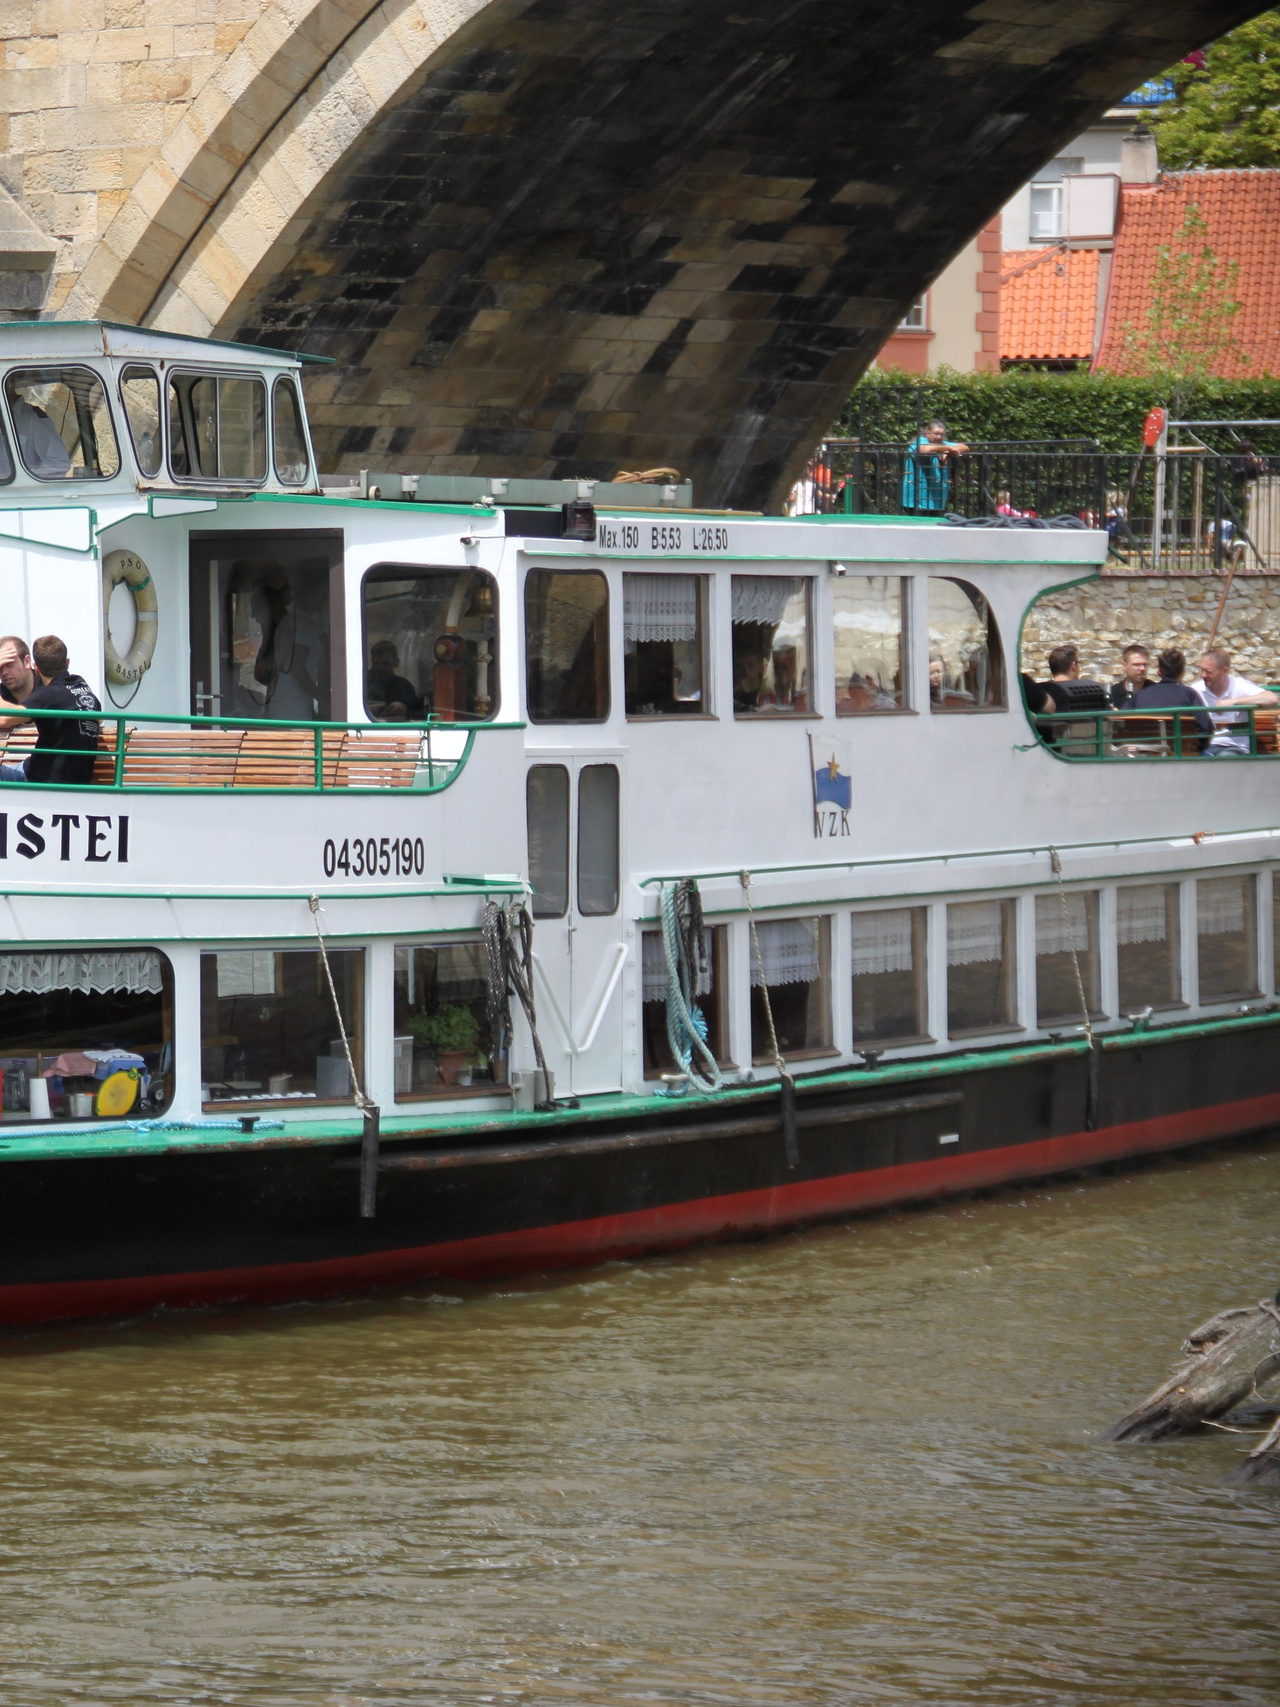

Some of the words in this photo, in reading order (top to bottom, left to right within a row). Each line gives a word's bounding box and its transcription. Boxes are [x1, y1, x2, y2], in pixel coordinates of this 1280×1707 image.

[651, 527, 682, 551] B:5,53
[693, 527, 728, 552] L:26,50
[120, 557, 142, 570] PSO
[115, 660, 147, 680] BASTEI
[323, 837, 425, 878] 04305190
